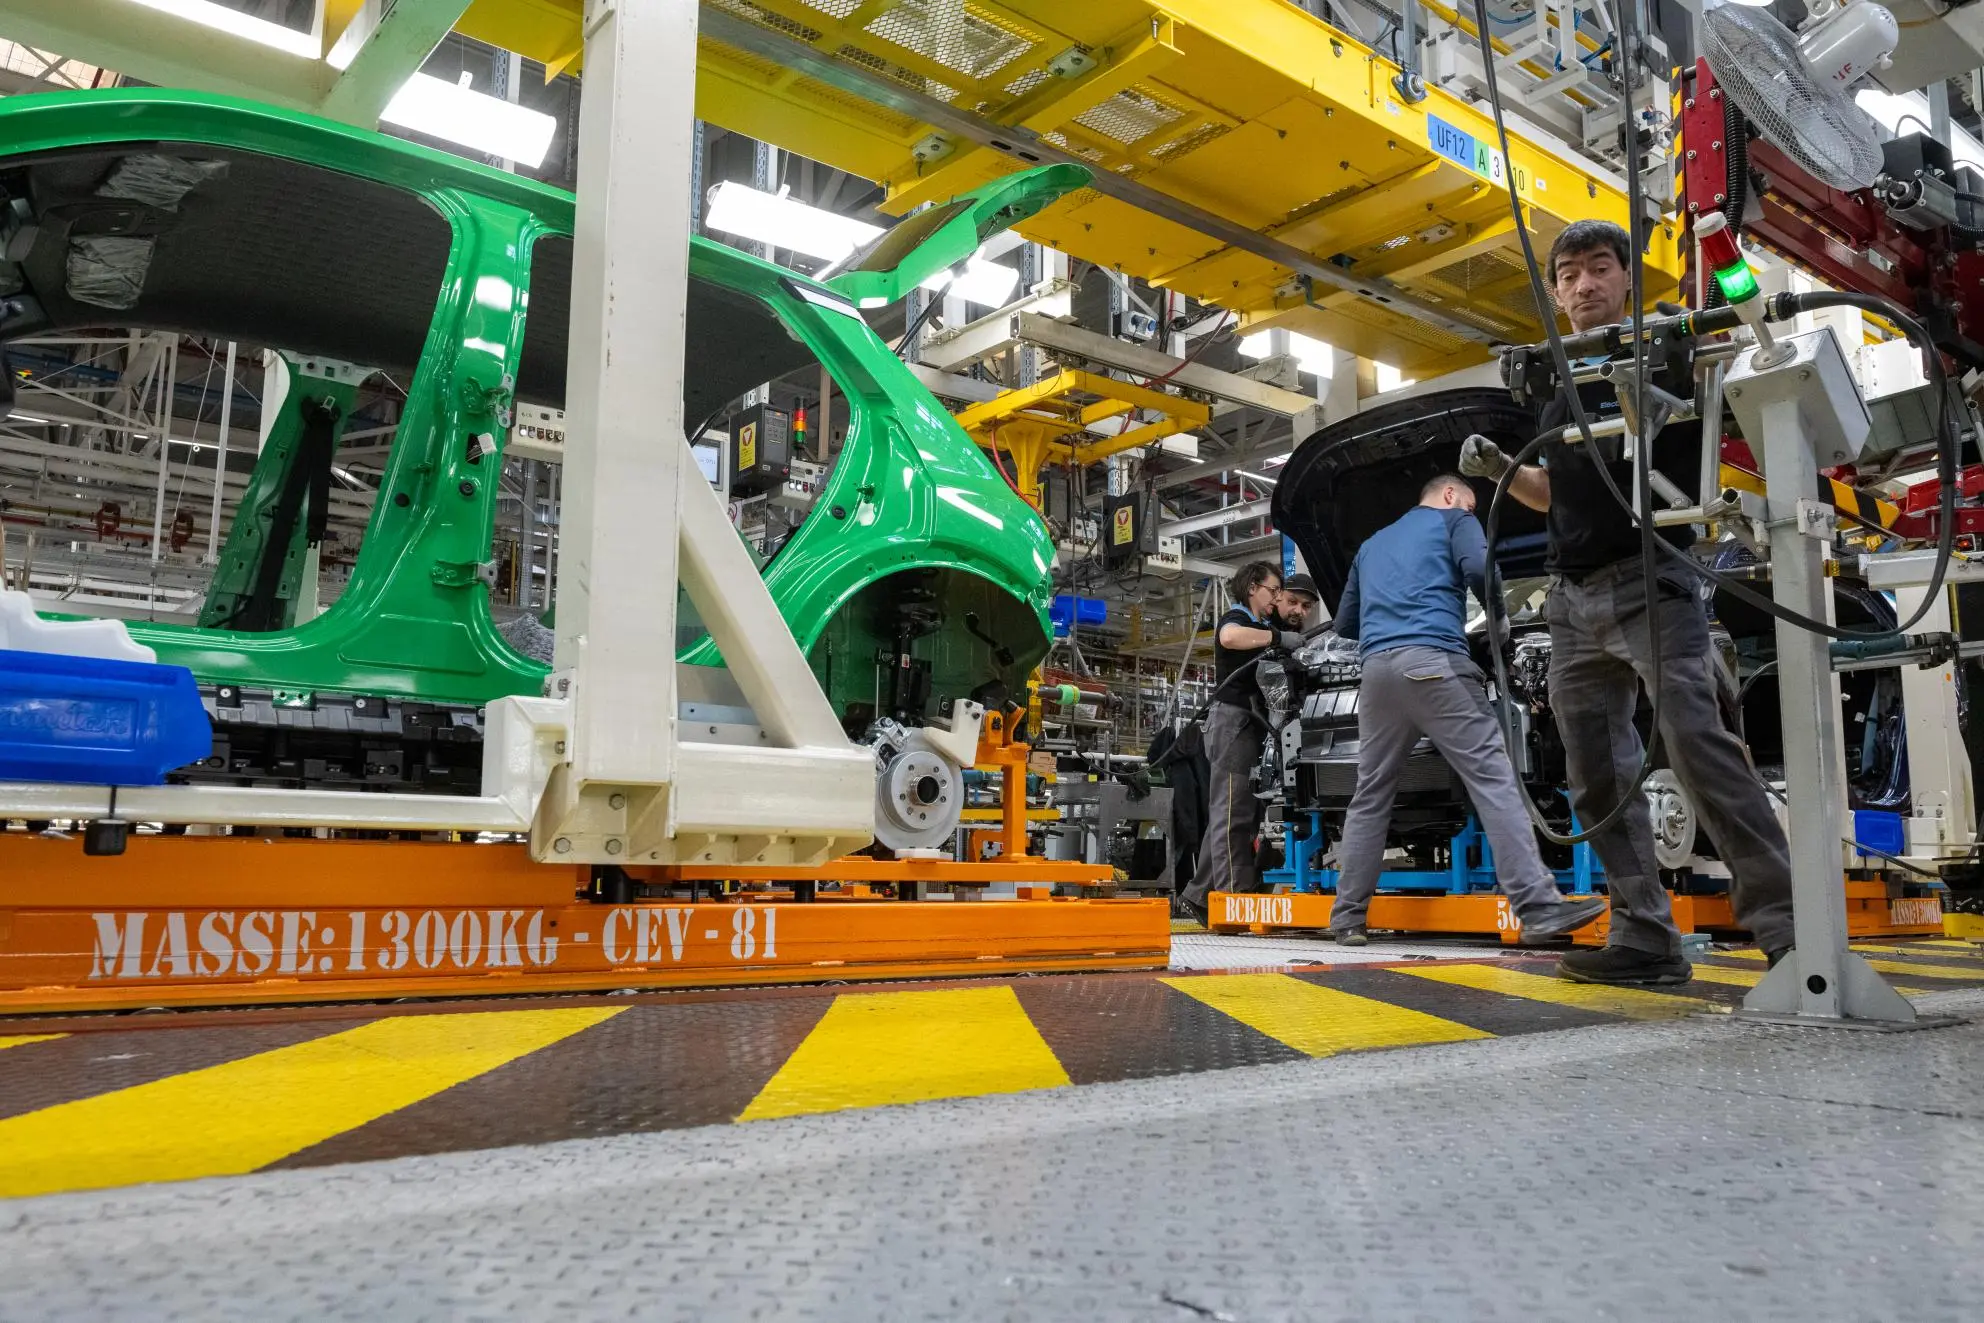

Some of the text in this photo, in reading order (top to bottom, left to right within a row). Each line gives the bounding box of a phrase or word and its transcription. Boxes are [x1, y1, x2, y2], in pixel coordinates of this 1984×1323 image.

[1437, 125, 1466, 161] UF12
[1478, 148, 1486, 171] A
[1493, 156, 1500, 178] 3
[602, 908, 694, 963] CEV
[730, 907, 777, 960] 81
[1225, 896, 1292, 924] BCB/HCB
